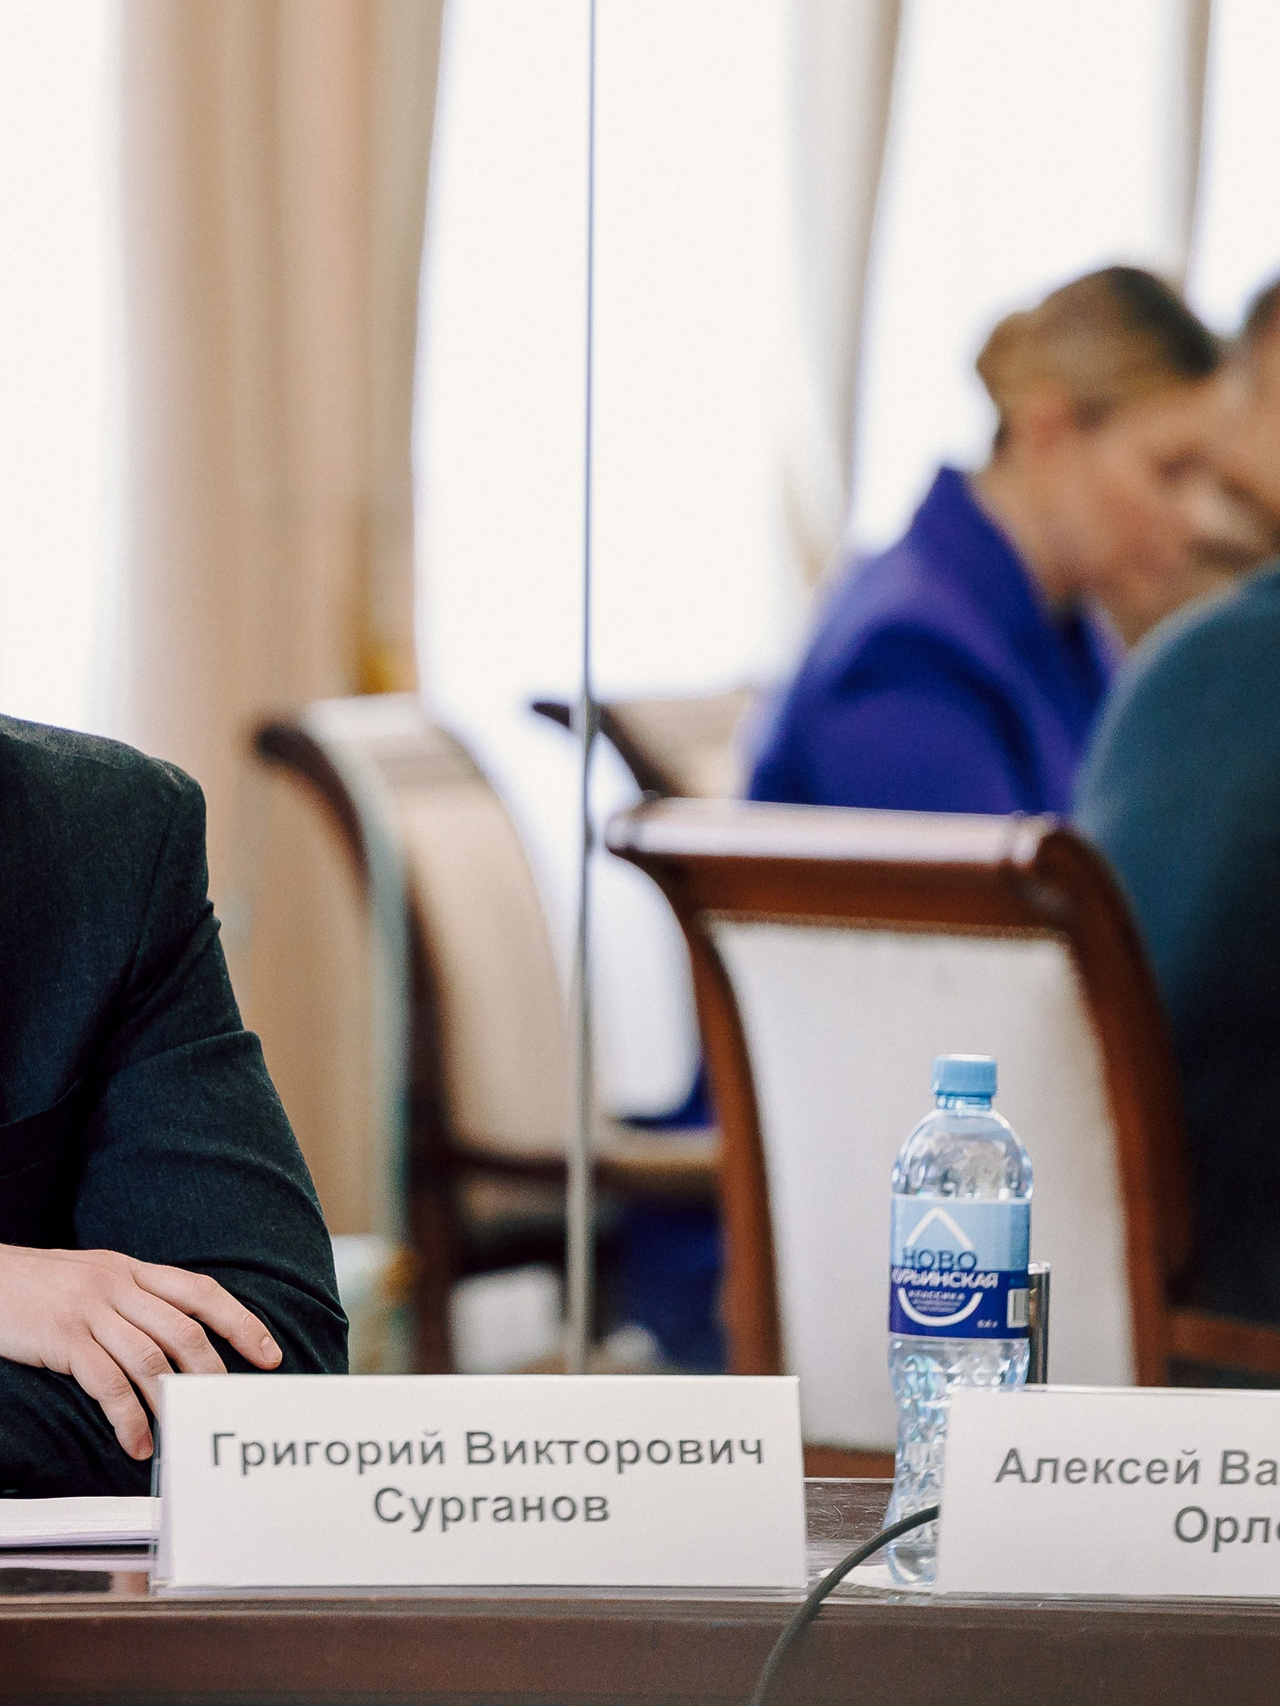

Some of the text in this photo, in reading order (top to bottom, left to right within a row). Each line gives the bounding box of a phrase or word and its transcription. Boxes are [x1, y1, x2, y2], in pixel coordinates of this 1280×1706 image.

[902, 1248, 978, 1272] НОВО
[211, 1430, 765, 1477] Григорий Викторович
[993, 1447, 1202, 1486] Алексей
[373, 1486, 611, 1534] Сурганов
[1174, 1505, 1280, 1553] Орл
